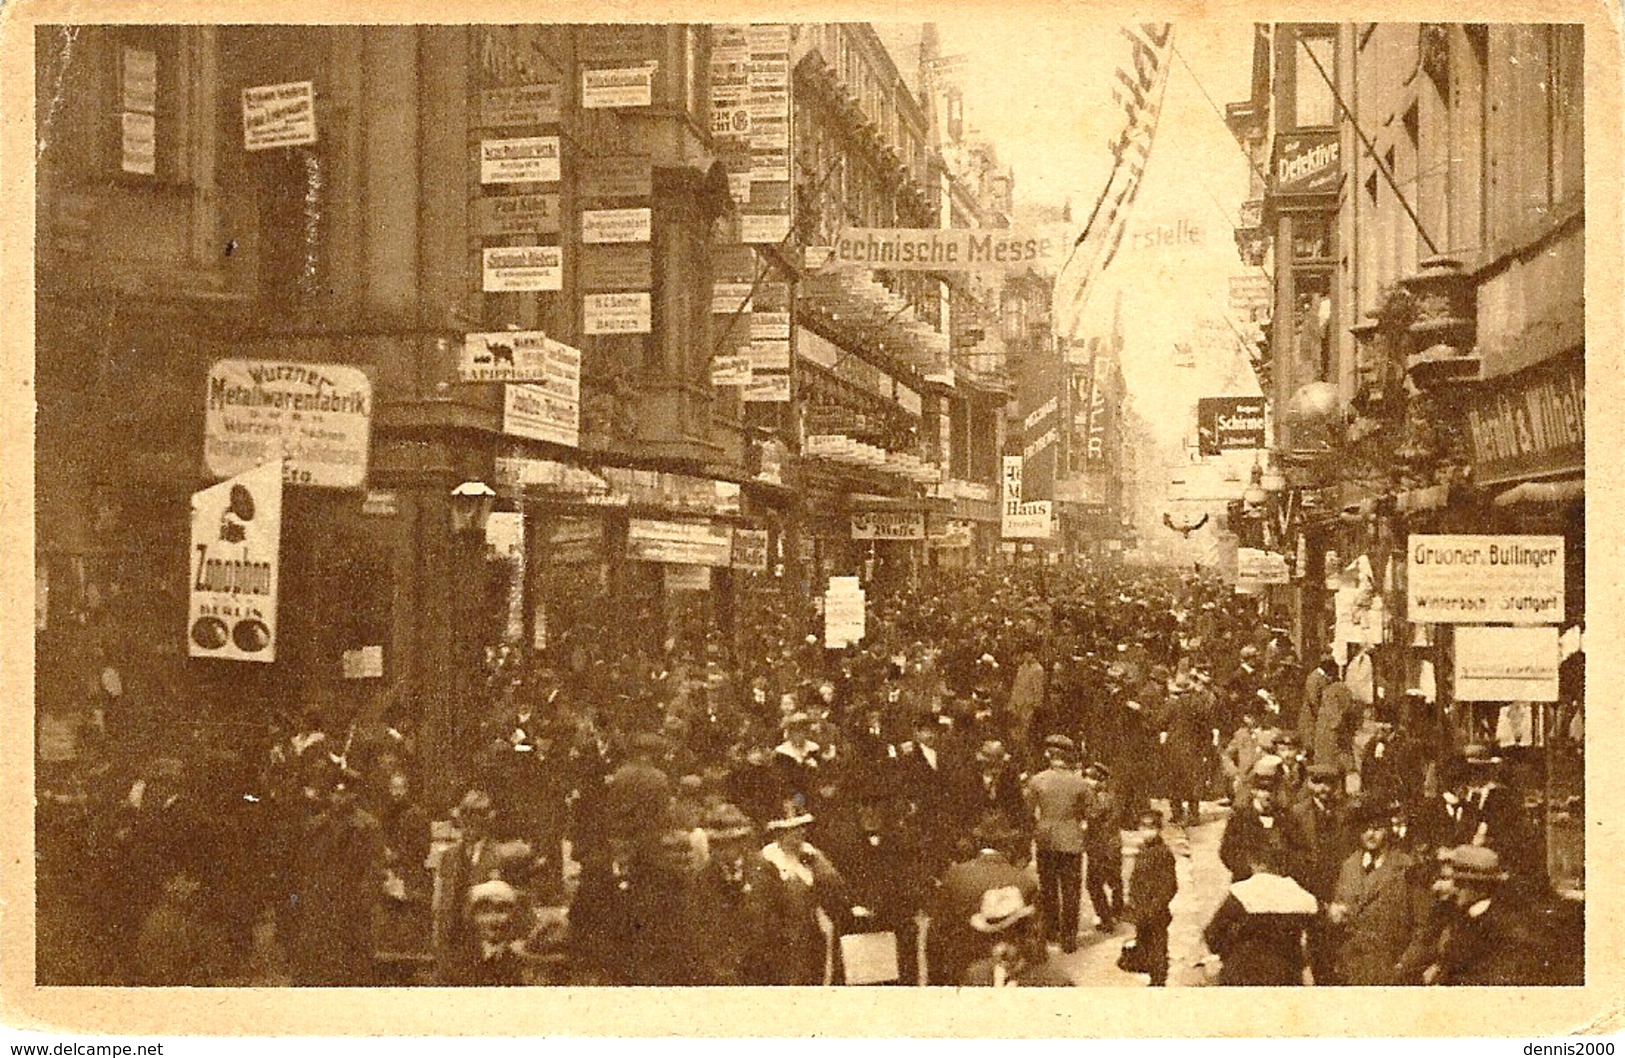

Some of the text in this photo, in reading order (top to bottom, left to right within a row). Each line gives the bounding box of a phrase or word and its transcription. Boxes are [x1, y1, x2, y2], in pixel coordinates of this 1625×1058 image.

[967, 232, 1051, 262] Messe
[209, 376, 367, 416] Metallwarenfabrik
[248, 365, 335, 397] Wurzner
[1006, 500, 1047, 516] Haus
[195, 543, 271, 598] Zonophon
[1490, 543, 1557, 568] Bullinger
[200, 603, 263, 618] BERLIN
